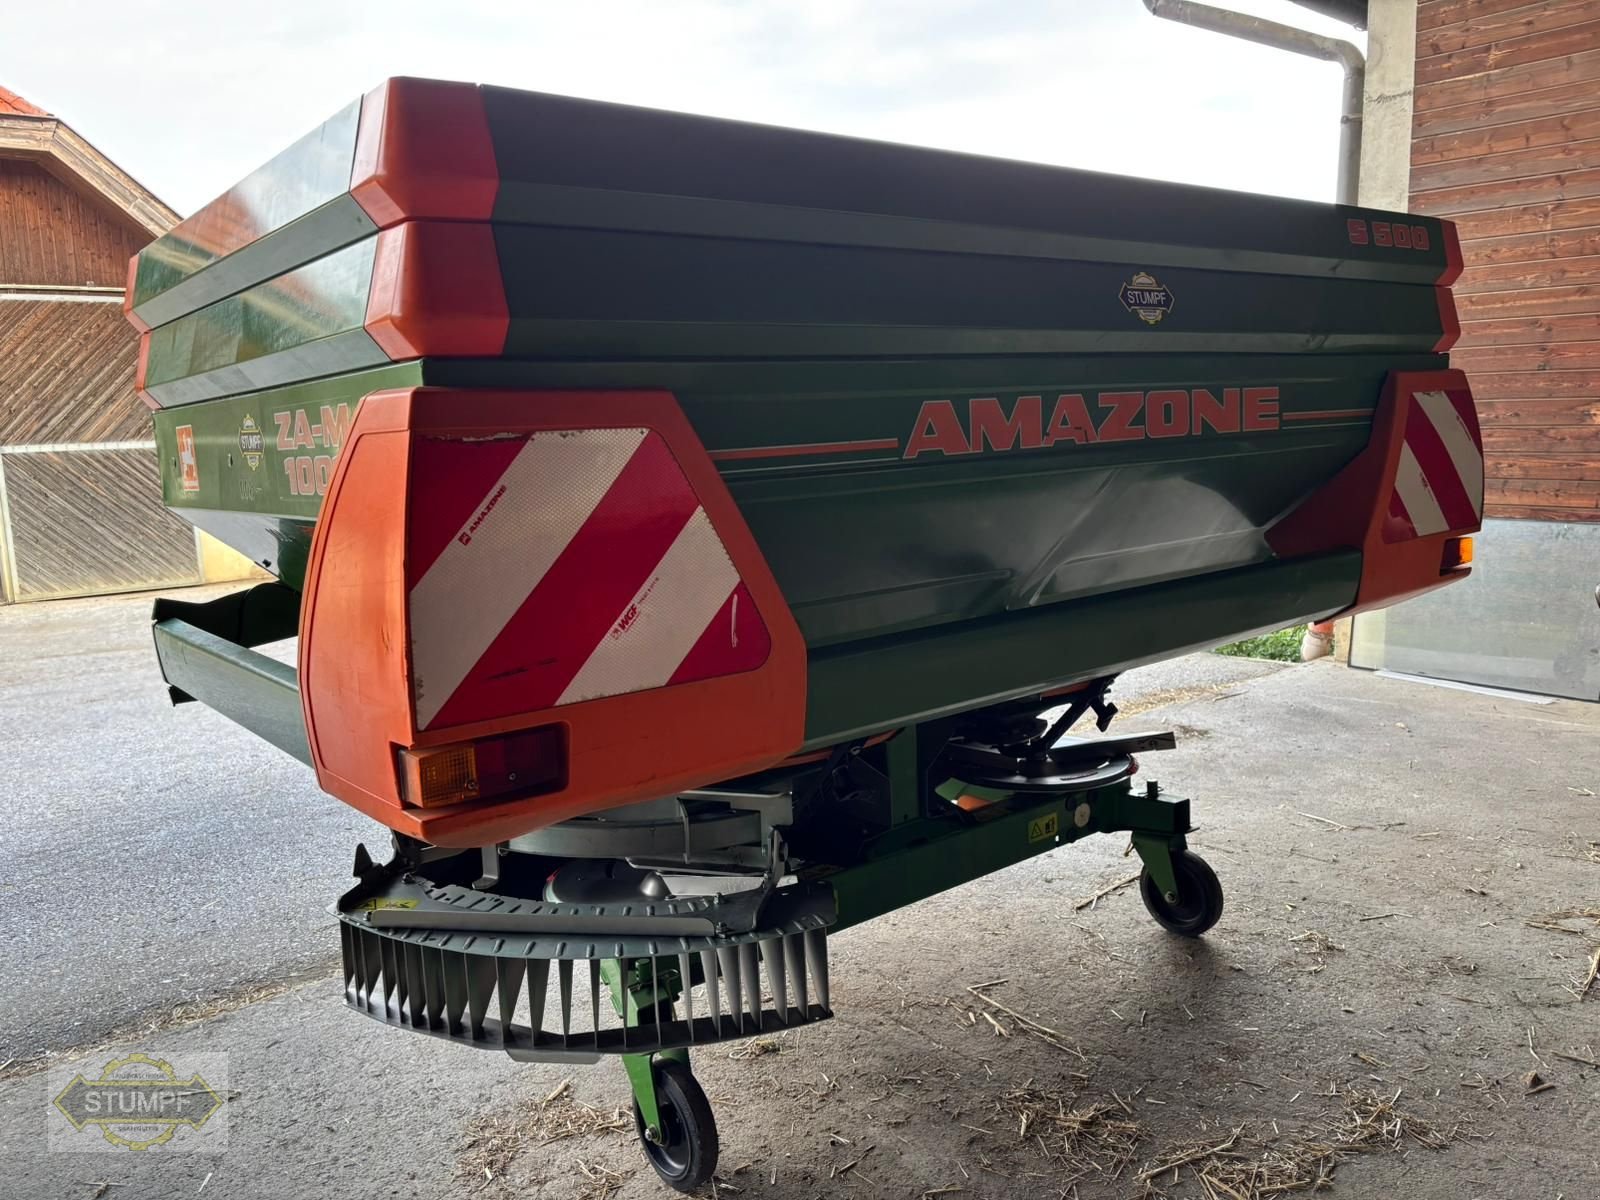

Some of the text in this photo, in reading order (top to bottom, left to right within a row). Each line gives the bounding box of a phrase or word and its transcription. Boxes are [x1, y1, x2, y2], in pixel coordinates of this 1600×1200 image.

[1346, 218, 1430, 251] S 500
[1127, 290, 1167, 305] STUMPF
[902, 386, 1280, 460] AMAZONE
[240, 434, 262, 450] STUMPF
[284, 455, 337, 496] 100
[469, 484, 507, 534] AMAZONE
